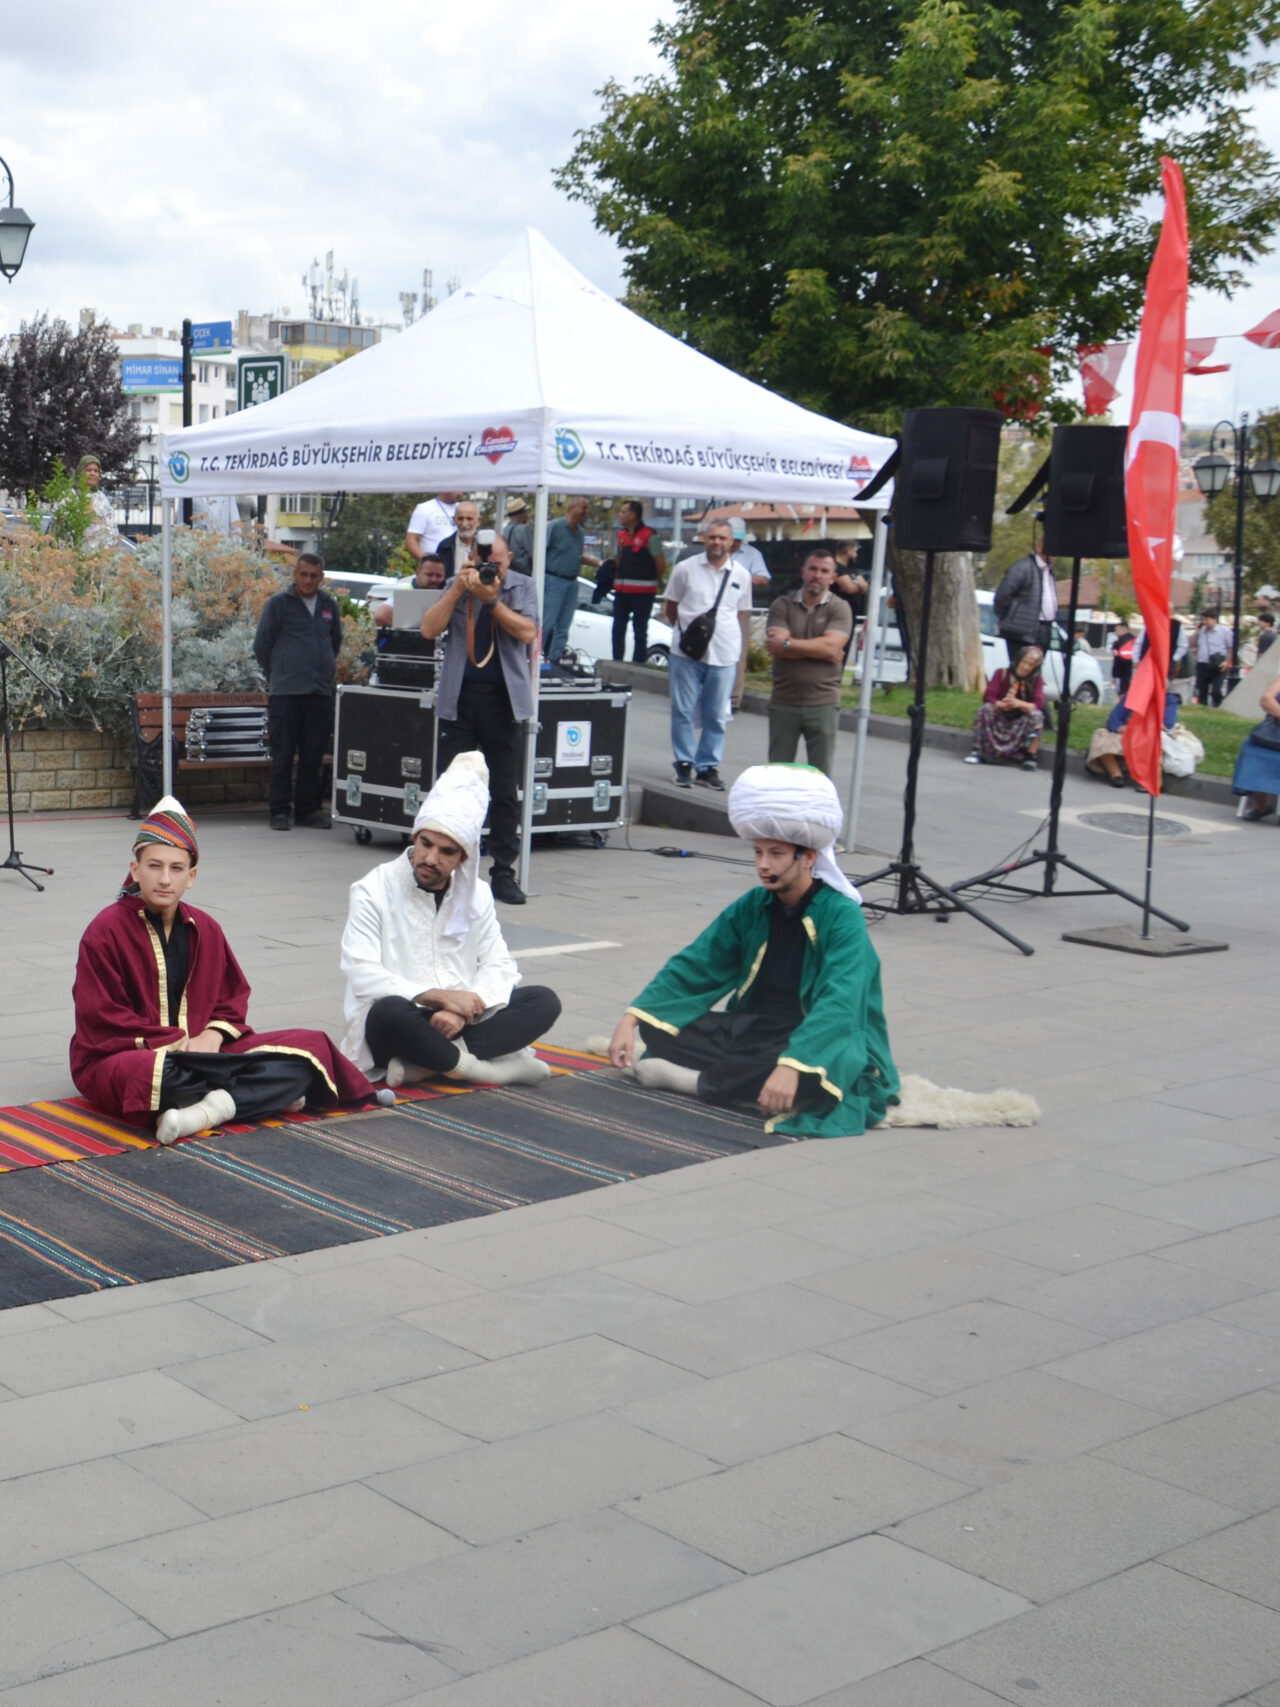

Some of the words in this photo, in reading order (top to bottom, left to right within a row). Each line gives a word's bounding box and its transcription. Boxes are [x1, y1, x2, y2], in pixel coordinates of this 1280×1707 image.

[126, 363, 152, 375] MİMAR
[154, 362, 179, 375] SİNAN
[200, 456, 220, 472] T.C.
[225, 446, 288, 470] TEKİRDAĞ
[292, 440, 382, 469] BÜYÜKŞEHİR
[386, 434, 472, 461] BELEDİYESİ
[596, 442, 623, 460] T.C.
[625, 440, 694, 466] TEKİRDAĞ
[697, 446, 779, 476] BÜYÜKŞEHİR
[781, 457, 844, 479] BELEDİYESİ
